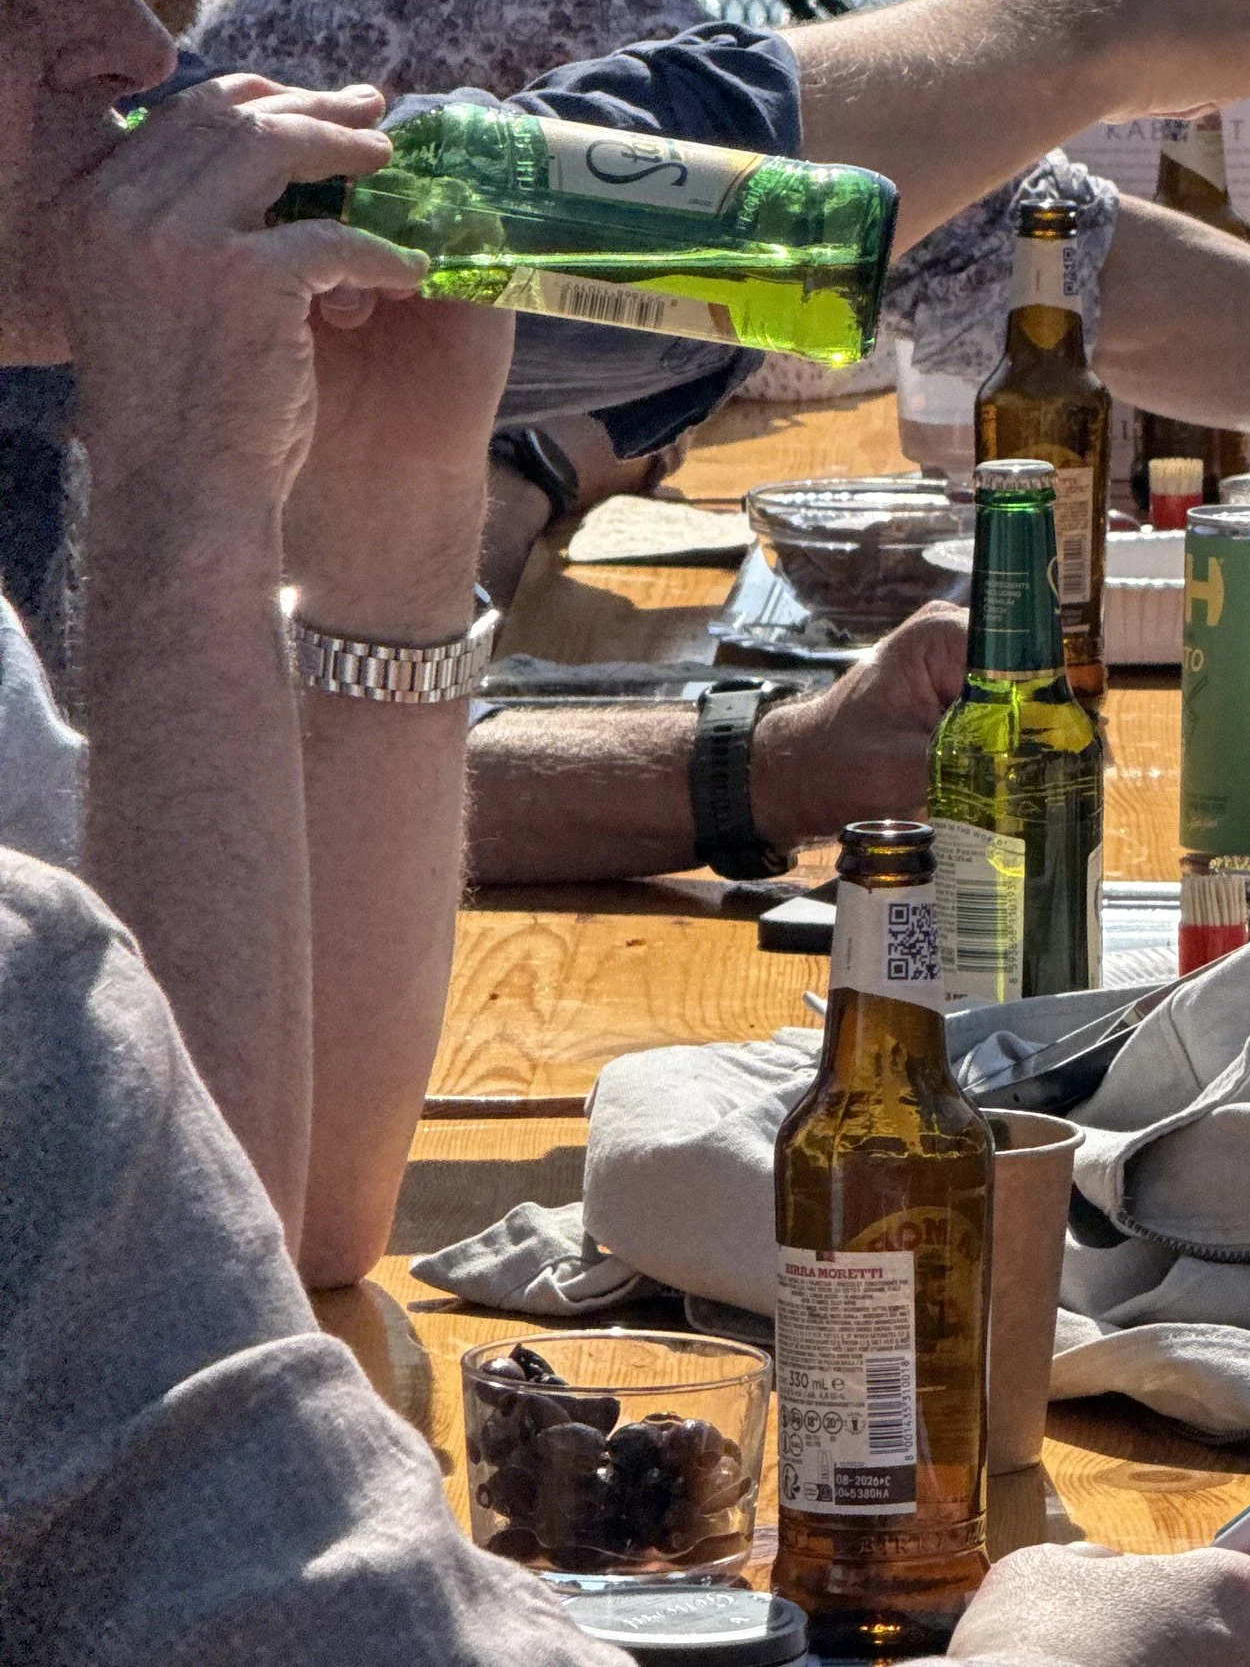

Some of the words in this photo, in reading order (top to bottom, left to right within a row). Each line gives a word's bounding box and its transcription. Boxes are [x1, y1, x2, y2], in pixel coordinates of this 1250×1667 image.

[785, 1262, 816, 1279] BIRRA
[817, 1266, 884, 1279] MORETTI
[788, 1370, 809, 1389] 330
[900, 1360, 913, 1402] 310018
[902, 1407, 914, 1448] 001435
[904, 1454, 915, 1462] 8
